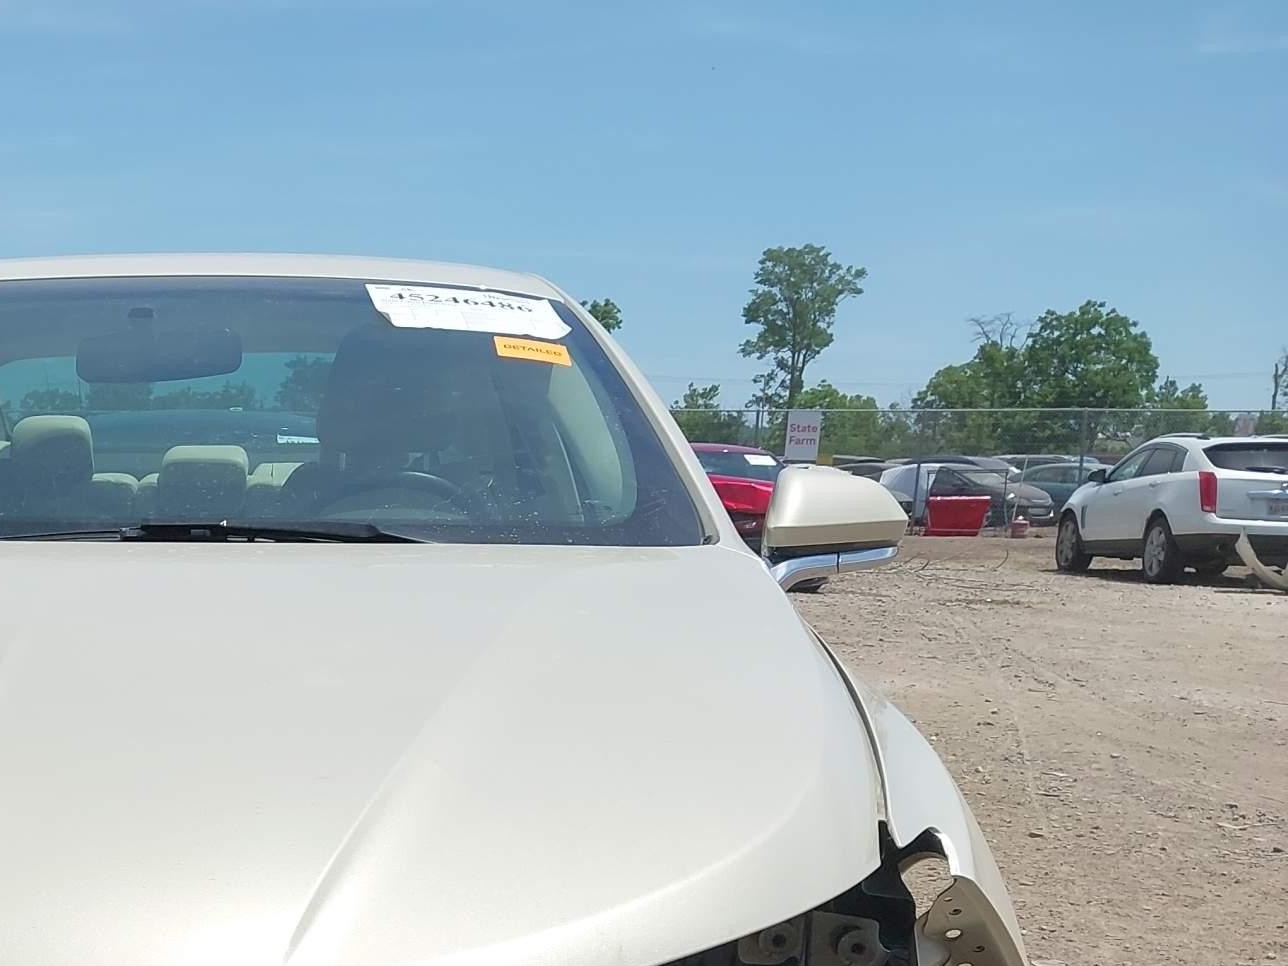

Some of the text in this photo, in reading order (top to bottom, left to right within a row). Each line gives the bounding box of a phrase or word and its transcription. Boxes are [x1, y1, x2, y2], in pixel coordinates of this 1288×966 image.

[390, 292, 533, 313] 45246486
[503, 343, 563, 357] DETAILED
[790, 423, 818, 433] State
[789, 435, 817, 446] Farm
